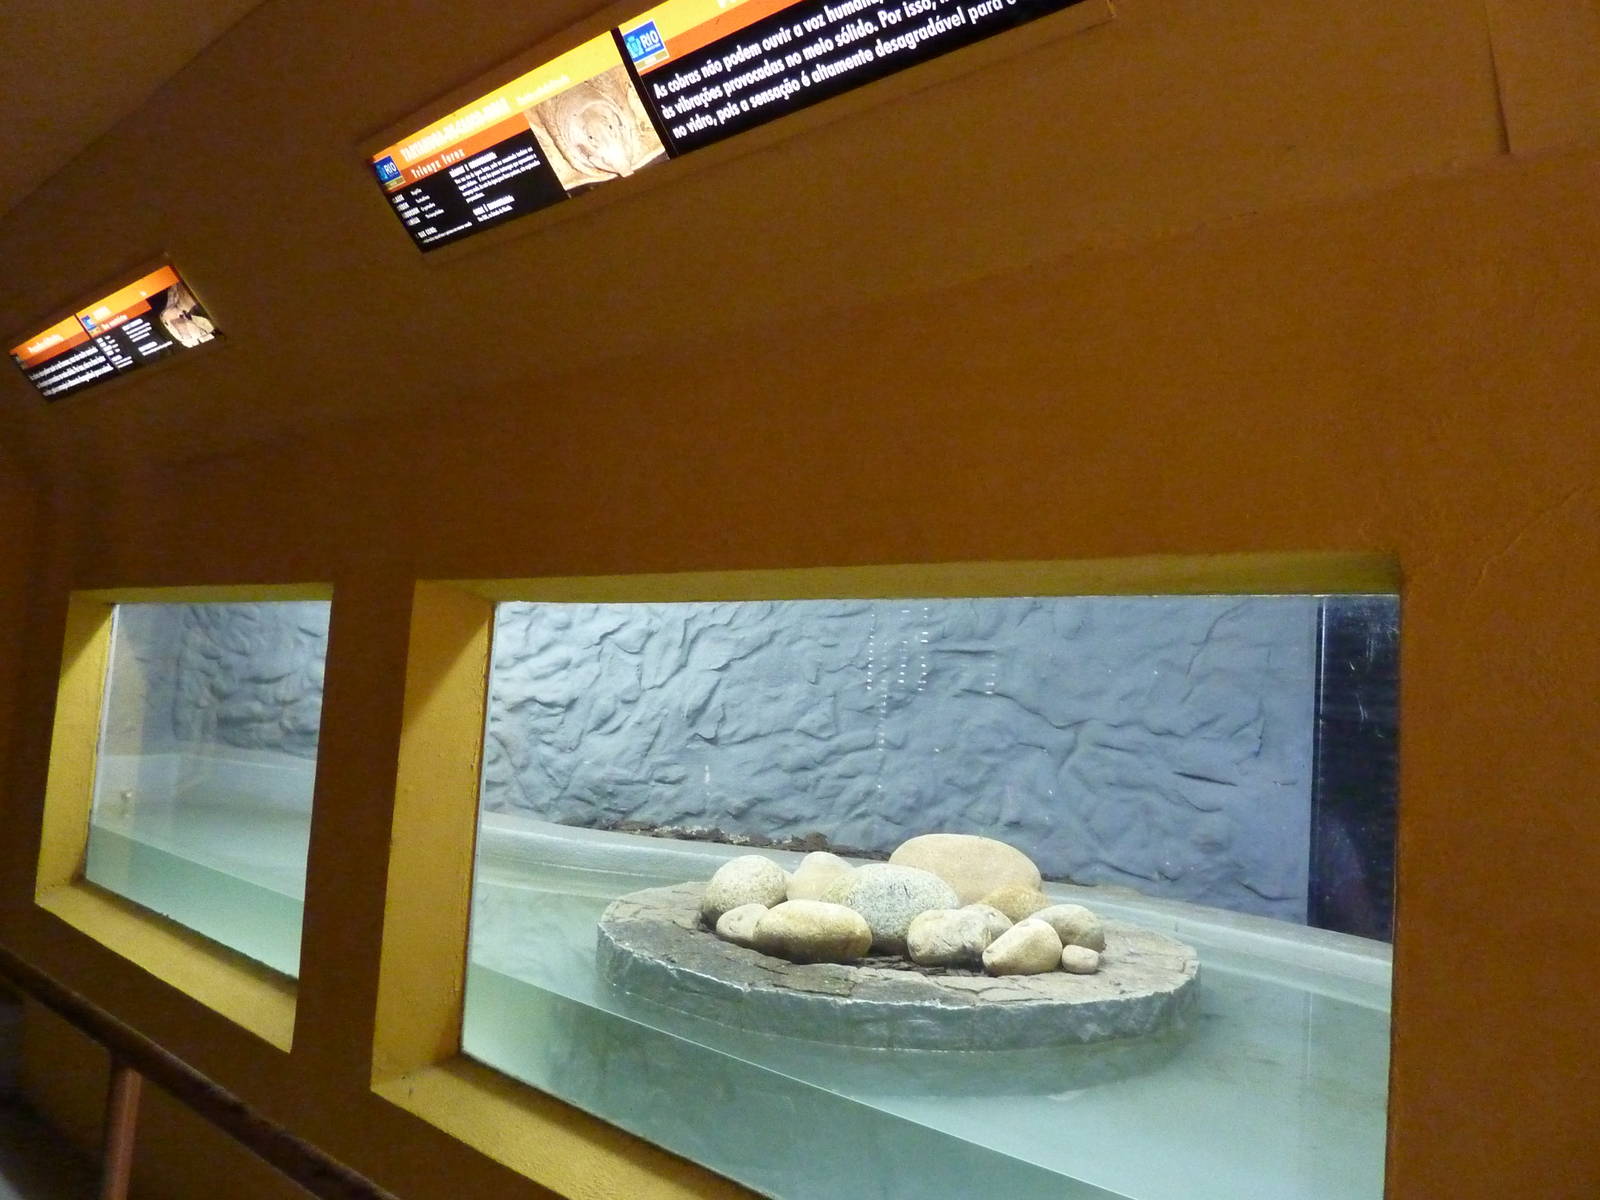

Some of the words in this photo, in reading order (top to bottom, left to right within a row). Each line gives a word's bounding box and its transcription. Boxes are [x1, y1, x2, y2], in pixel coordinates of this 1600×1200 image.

[640, 30, 660, 48] RIO
[653, 83, 668, 99] As
[668, 73, 701, 93] cobras
[701, 59, 723, 78] não
[723, 44, 762, 72] podem
[762, 27, 792, 51] ouvir
[793, 24, 803, 37] a
[803, 14, 827, 32] voz
[824, 0, 884, 23] human,
[661, 105, 676, 119] às
[674, 87, 723, 114] vibrações
[723, 59, 785, 98] provocadas
[785, 52, 802, 67] no
[802, 37, 834, 60] meio
[835, 18, 879, 47] sólido.
[877, 10, 901, 28] Por
[903, 0, 936, 18] isso,
[672, 125, 688, 139] no
[686, 113, 718, 133] vidro,
[716, 102, 740, 125] pois
[740, 100, 750, 112] a
[749, 78, 800, 108] sensação
[801, 70, 811, 87] é
[811, 49, 874, 83] altamente
[875, 6, 966, 57] desagradável
[967, 0, 1003, 24] para
